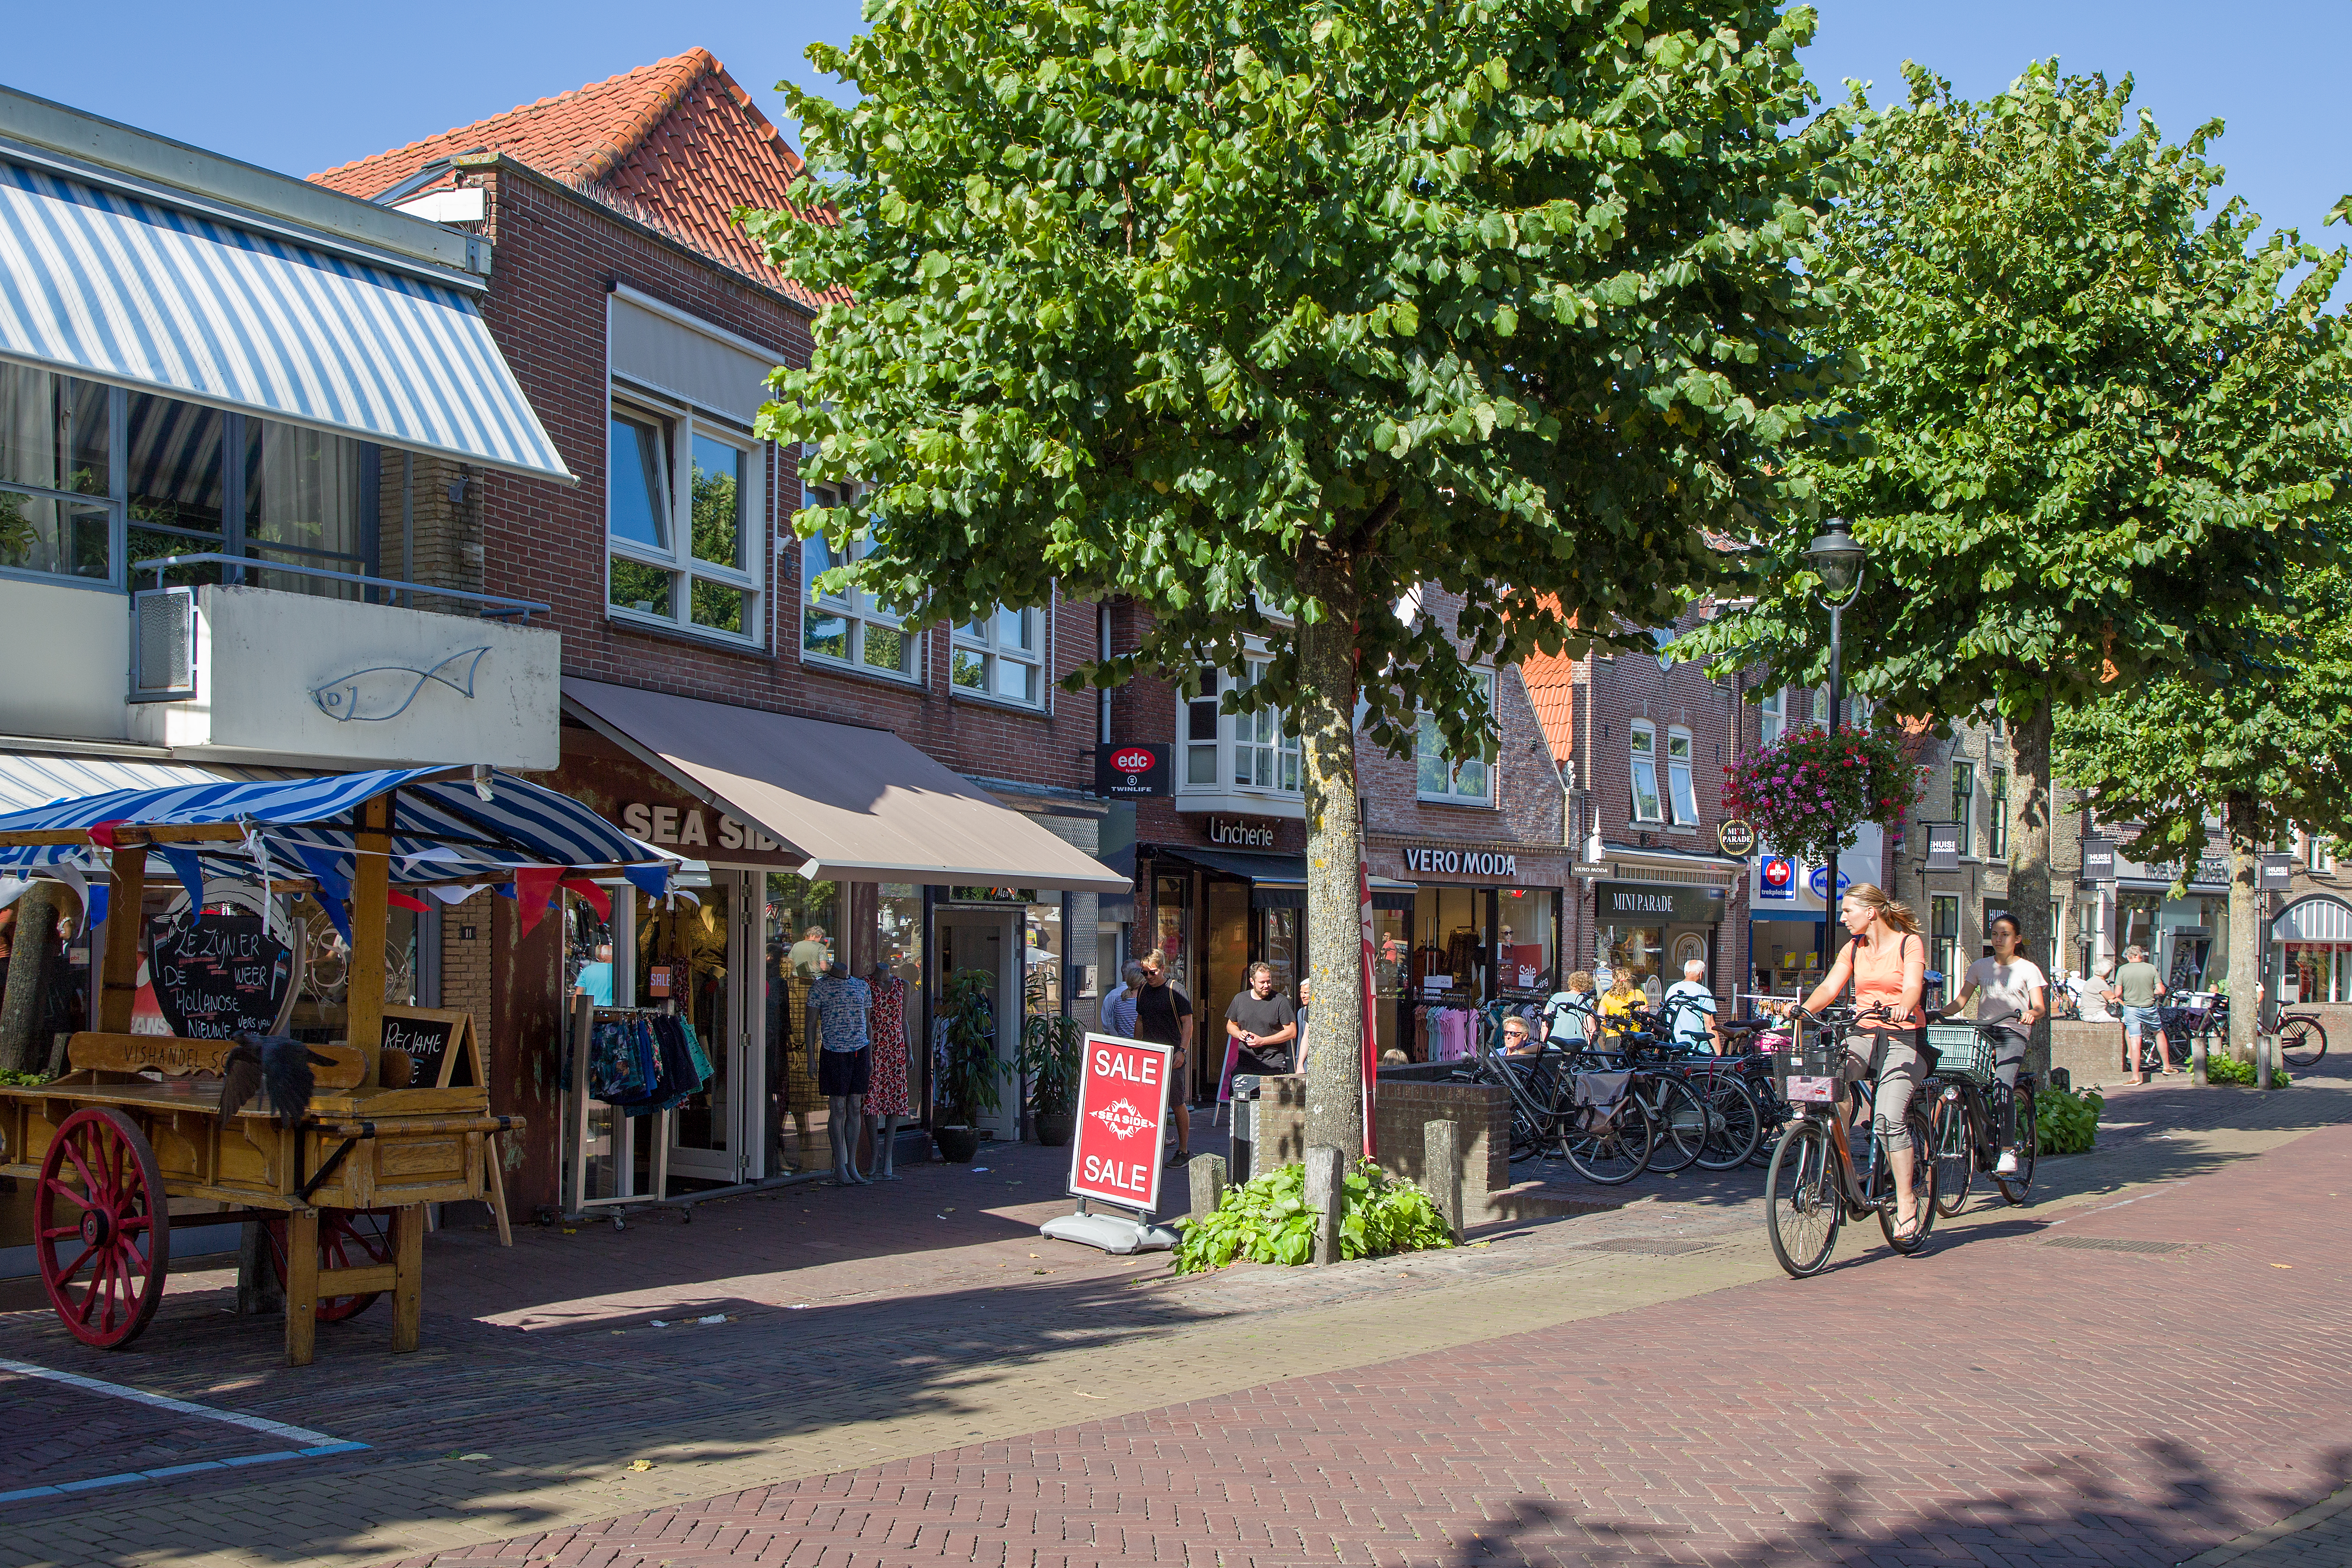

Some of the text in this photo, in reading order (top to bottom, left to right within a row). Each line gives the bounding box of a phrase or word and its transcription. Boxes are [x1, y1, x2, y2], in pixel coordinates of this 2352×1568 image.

[1118, 753, 1147, 767] edc
[623, 803, 708, 846] SEA
[1211, 817, 1273, 846] Lincherie
[1407, 849, 1517, 876] VERO MODA
[1612, 893, 1673, 912] MINI PARADE
[465, 928, 471, 938] 11
[240, 934, 260, 957] ER
[165, 965, 267, 986] DE WEER
[651, 973, 670, 986] SALE
[1519, 964, 1536, 978] Sale
[176, 988, 241, 1016] HOLLANDSE
[132, 1017, 168, 1035] ANS
[238, 1015, 271, 1029] VERS VAN
[385, 1022, 441, 1054] RECLAME
[125, 1044, 200, 1068] VISHANDEL
[1094, 1049, 1158, 1085] SALE
[1098, 1109, 1149, 1128] SEA SIDE
[1084, 1154, 1148, 1193] SALE
